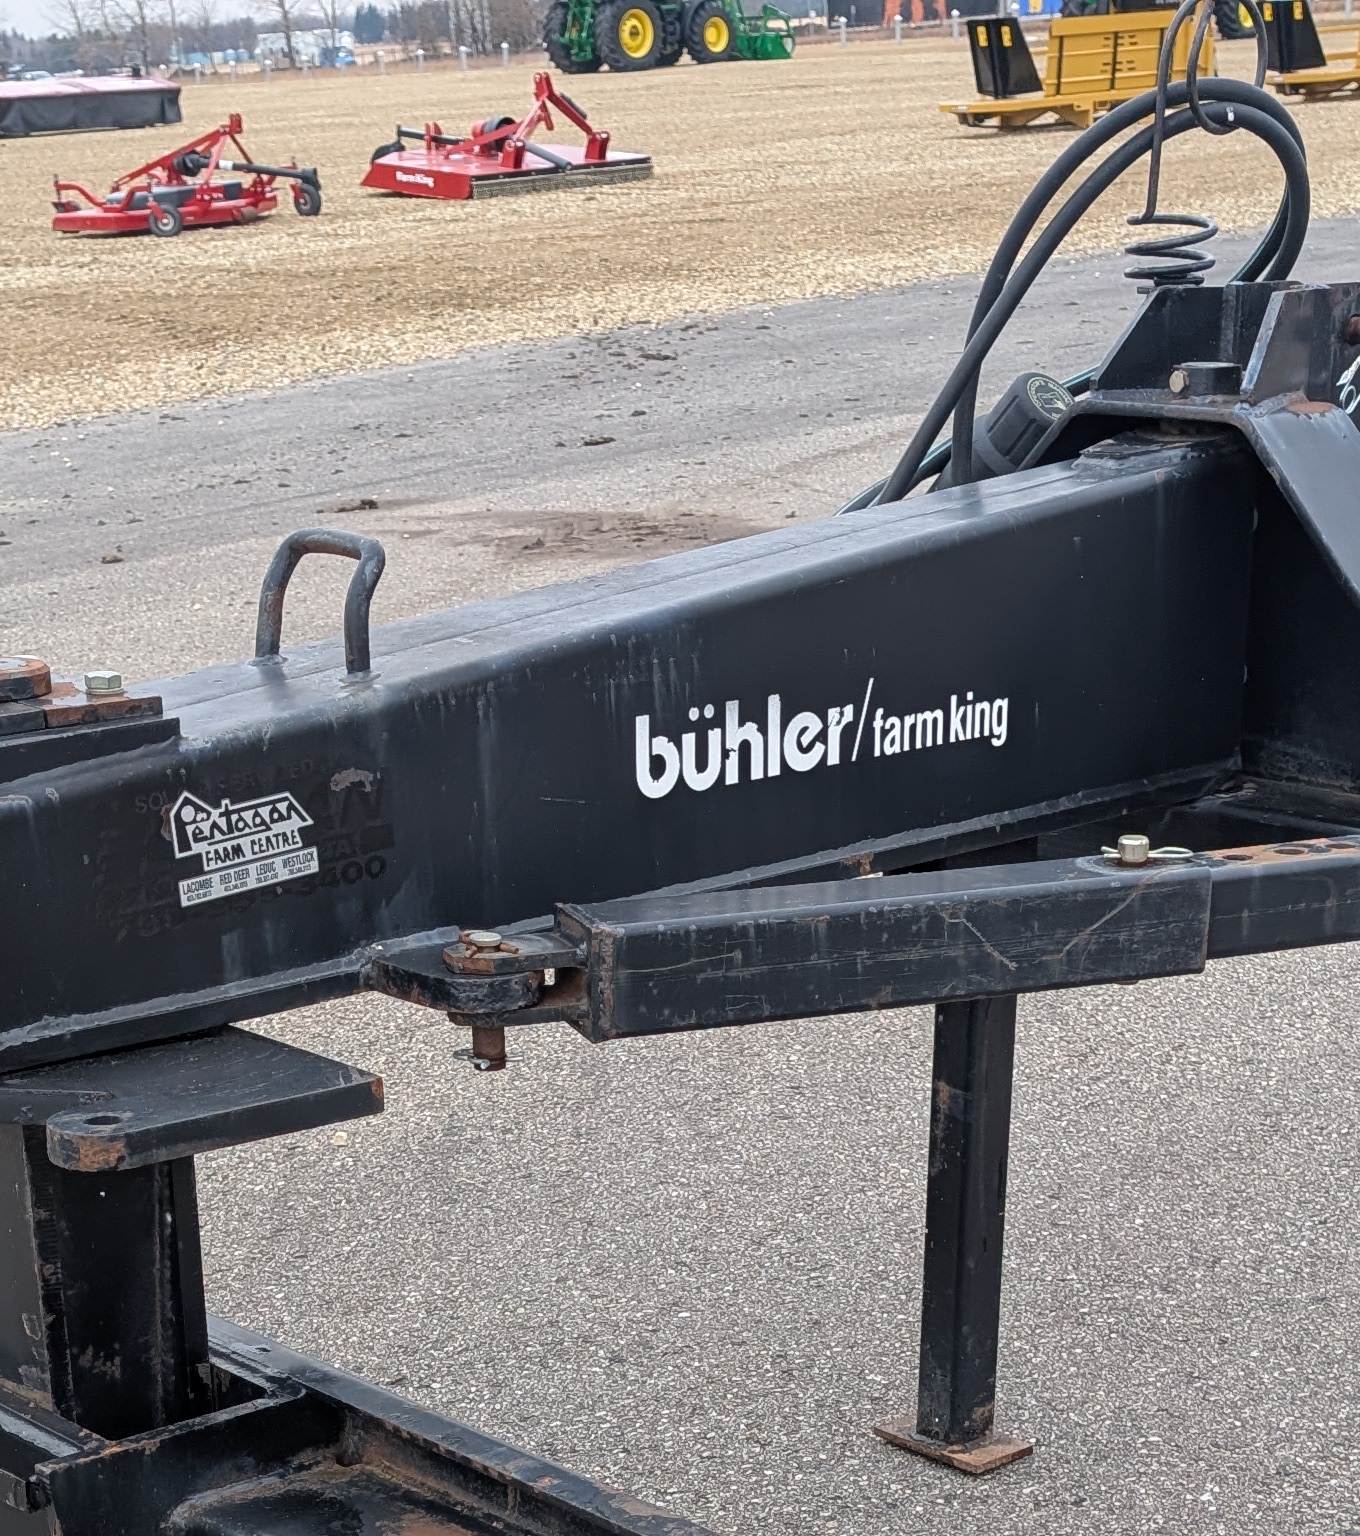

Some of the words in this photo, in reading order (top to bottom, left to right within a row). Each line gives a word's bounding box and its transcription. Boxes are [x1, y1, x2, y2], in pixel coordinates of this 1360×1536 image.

[635, 693, 854, 799] bühler
[872, 705, 944, 757] farm
[949, 691, 1009, 747] king
[204, 842, 247, 868] FARM
[249, 829, 300, 856] CENTRE
[255, 861, 277, 876] LEDUC
[281, 850, 316, 870] WESTLOCK
